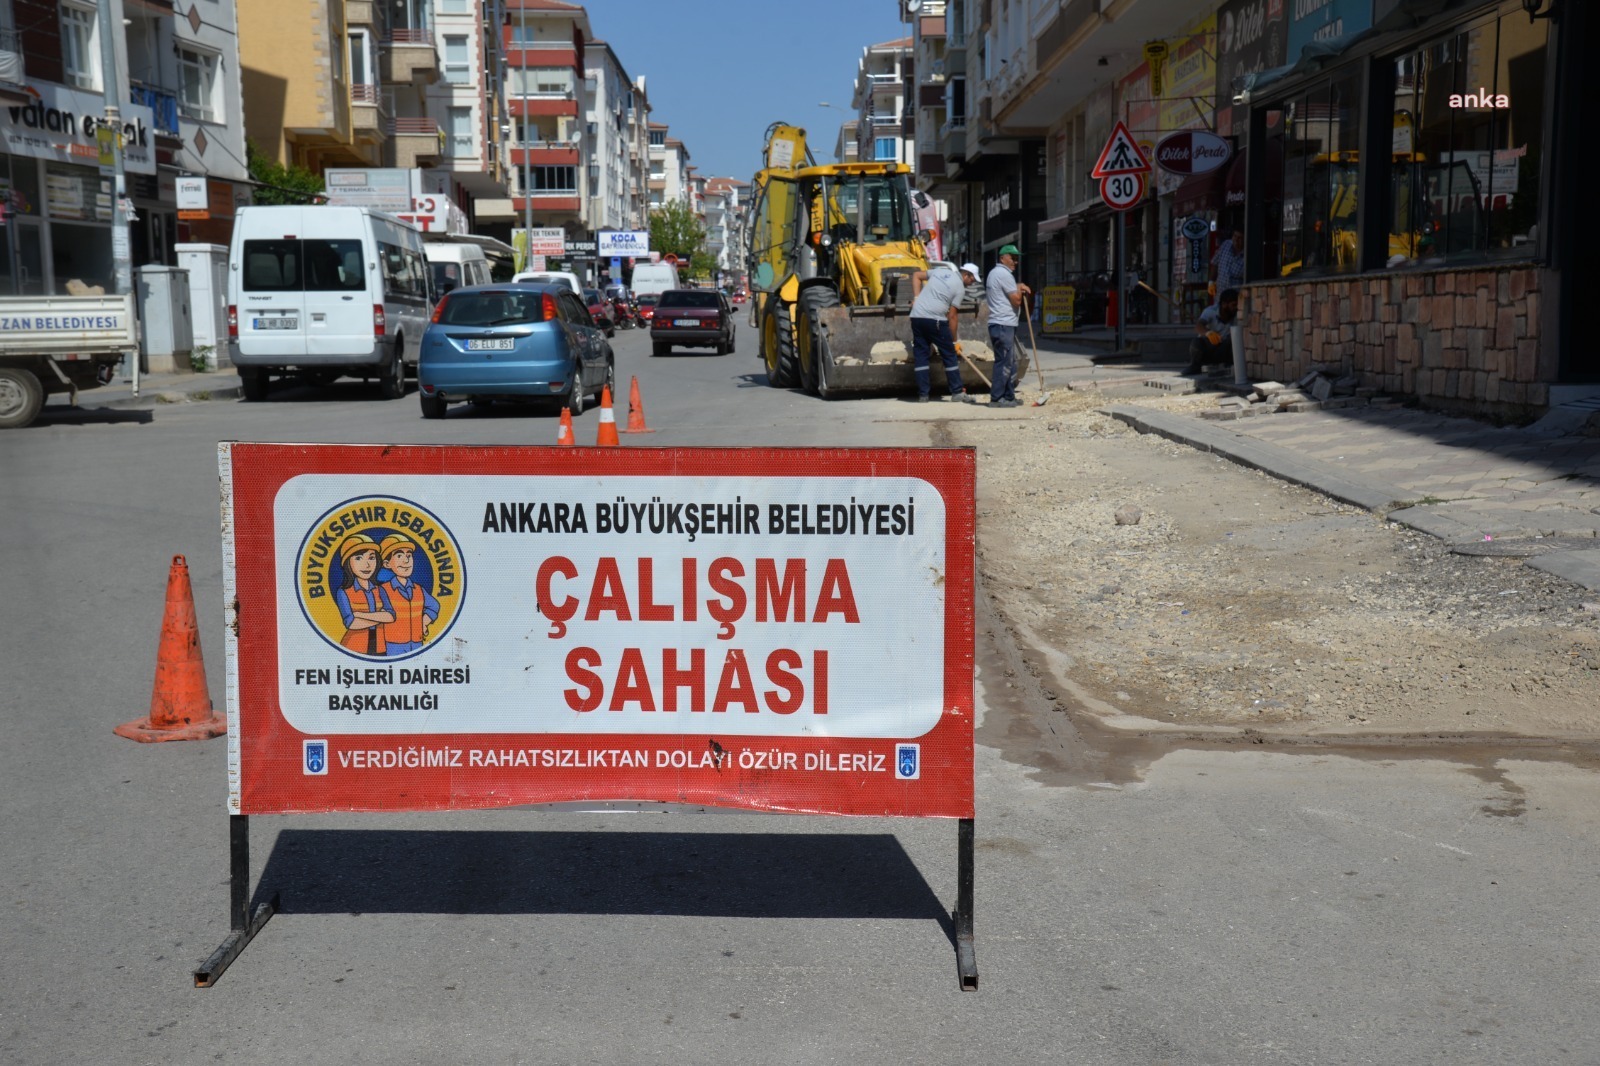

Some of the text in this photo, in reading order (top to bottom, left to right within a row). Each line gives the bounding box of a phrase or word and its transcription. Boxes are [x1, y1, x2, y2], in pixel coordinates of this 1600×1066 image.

[1160, 146, 1226, 161] Dilek Perde
[1112, 177, 1133, 198] 30
[611, 233, 637, 242] KOCA
[0, 317, 31, 330] ZAN
[469, 340, 478, 348] 06
[482, 496, 915, 542] ANKARA BÜYÜKŞEHİR BELEDİYESİ
[535, 555, 861, 640] ÇALIŞMA
[295, 665, 470, 688] FEN İŞLERİ DAİRESİ
[563, 646, 829, 715] SAHASI
[328, 691, 438, 715] BAŞKANLIĞI
[337, 746, 463, 768] VERDİĞİMİZ
[469, 749, 649, 768] RAHATSIZLIKTAN
[738, 748, 798, 770] ÖZÜR
[804, 749, 886, 772] DİLERİZ
